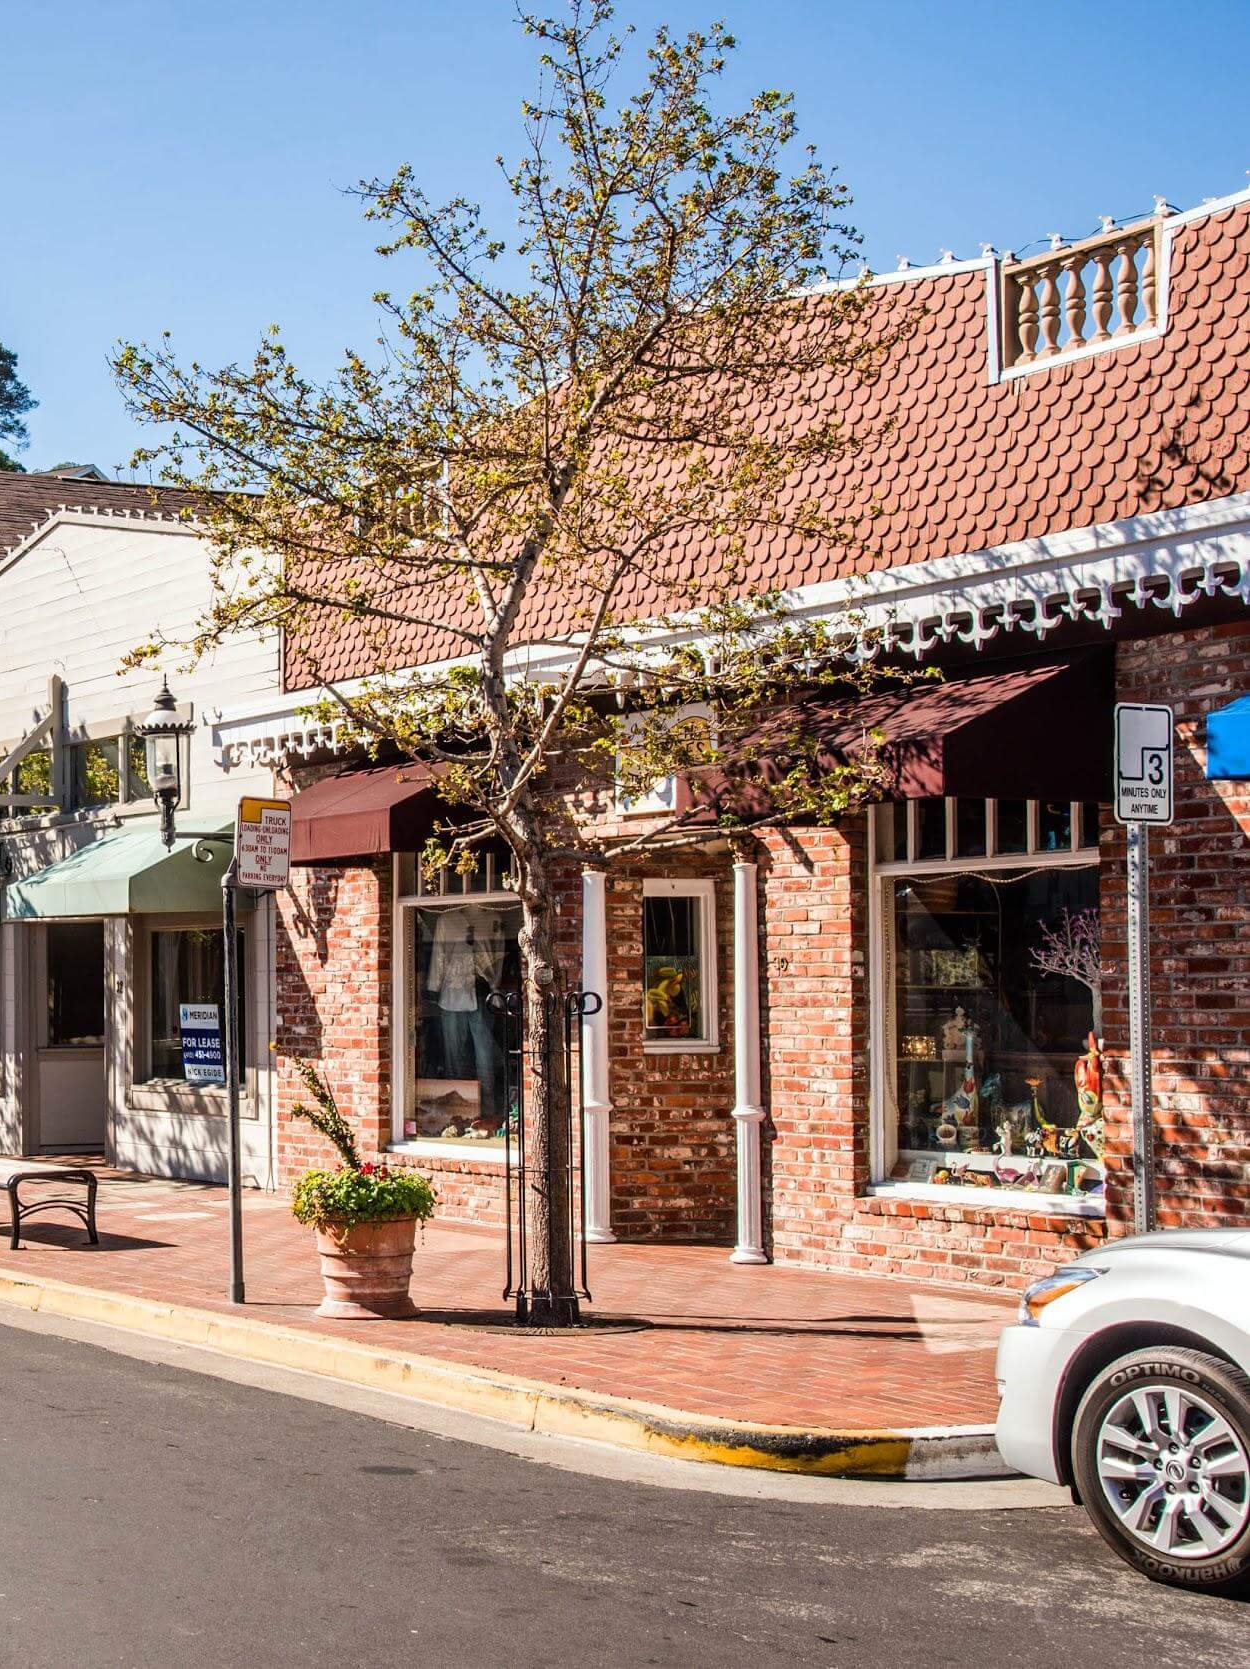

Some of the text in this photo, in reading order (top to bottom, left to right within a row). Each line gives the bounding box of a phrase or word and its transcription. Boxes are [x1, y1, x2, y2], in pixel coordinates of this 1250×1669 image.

[1148, 753, 1164, 785] 3
[1121, 786, 1167, 799] MINUTES ONLY
[1131, 803, 1158, 814] ANYTIME
[265, 816, 287, 826] TRUCK
[256, 835, 273, 843] ONLY
[255, 855, 272, 864] ONLY
[242, 872, 286, 882] PARKING EVERYDAY
[190, 1010, 218, 1020] MERIDIAN
[182, 1037, 220, 1048] FOR LEASE
[204, 1069, 222, 1077] EGIDE
[1110, 1363, 1200, 1387] OPTIMO
